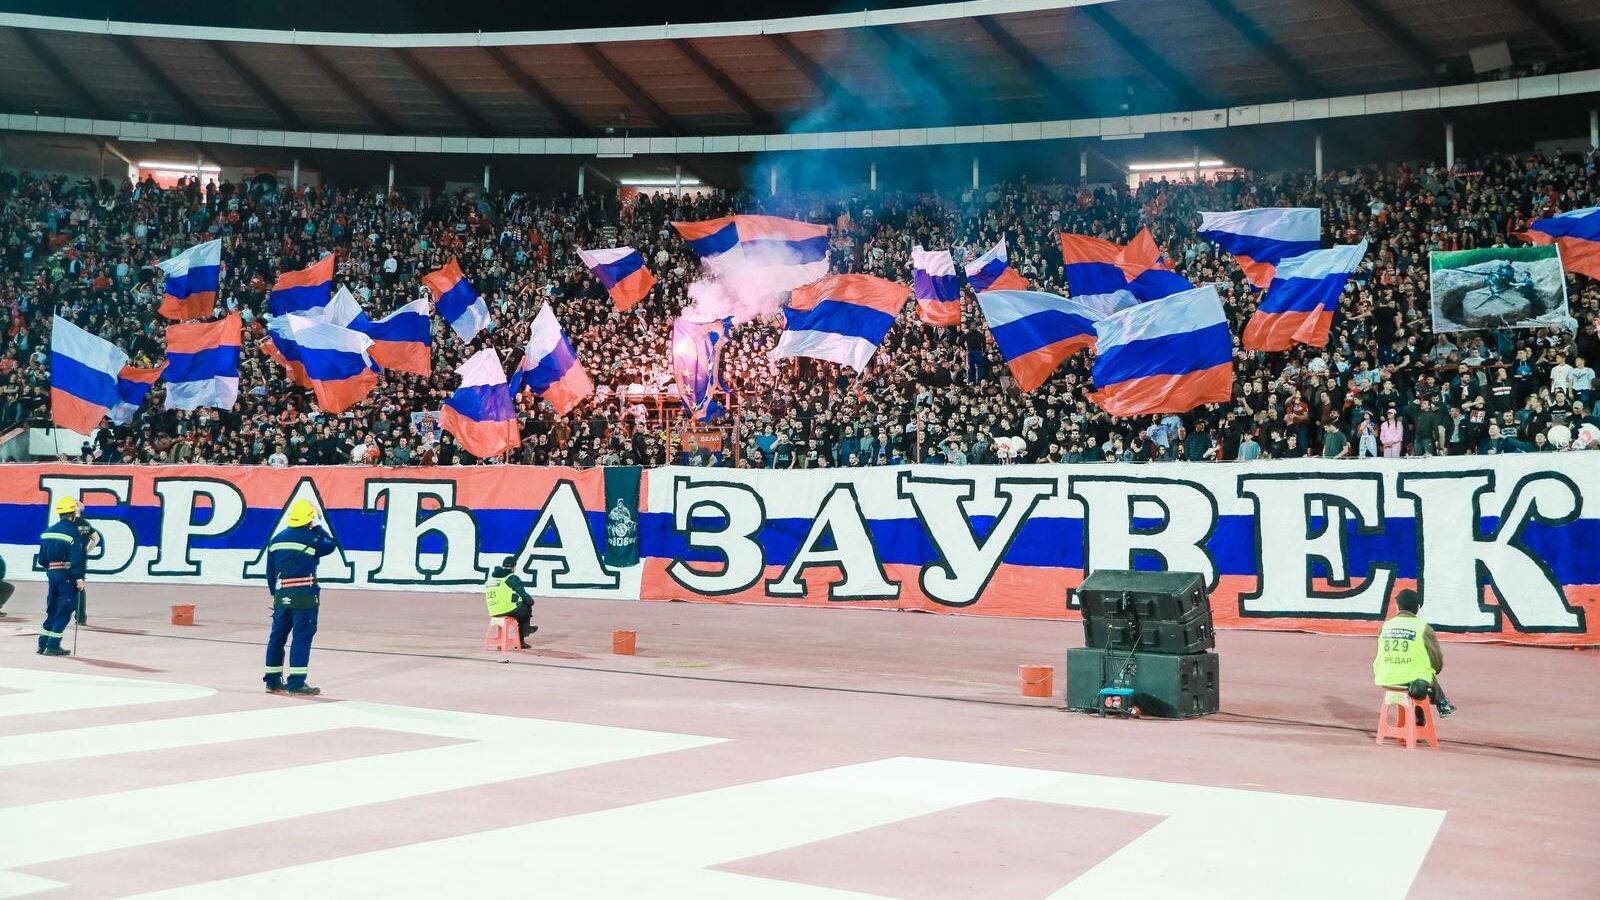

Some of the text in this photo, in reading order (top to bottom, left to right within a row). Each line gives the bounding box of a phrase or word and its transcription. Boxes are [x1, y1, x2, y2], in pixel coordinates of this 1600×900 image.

[32, 469, 1586, 634] БРАЋА ЗАУВЕК
[1384, 640, 1409, 652] 829
[1384, 656, 1412, 665] РЕДАР
